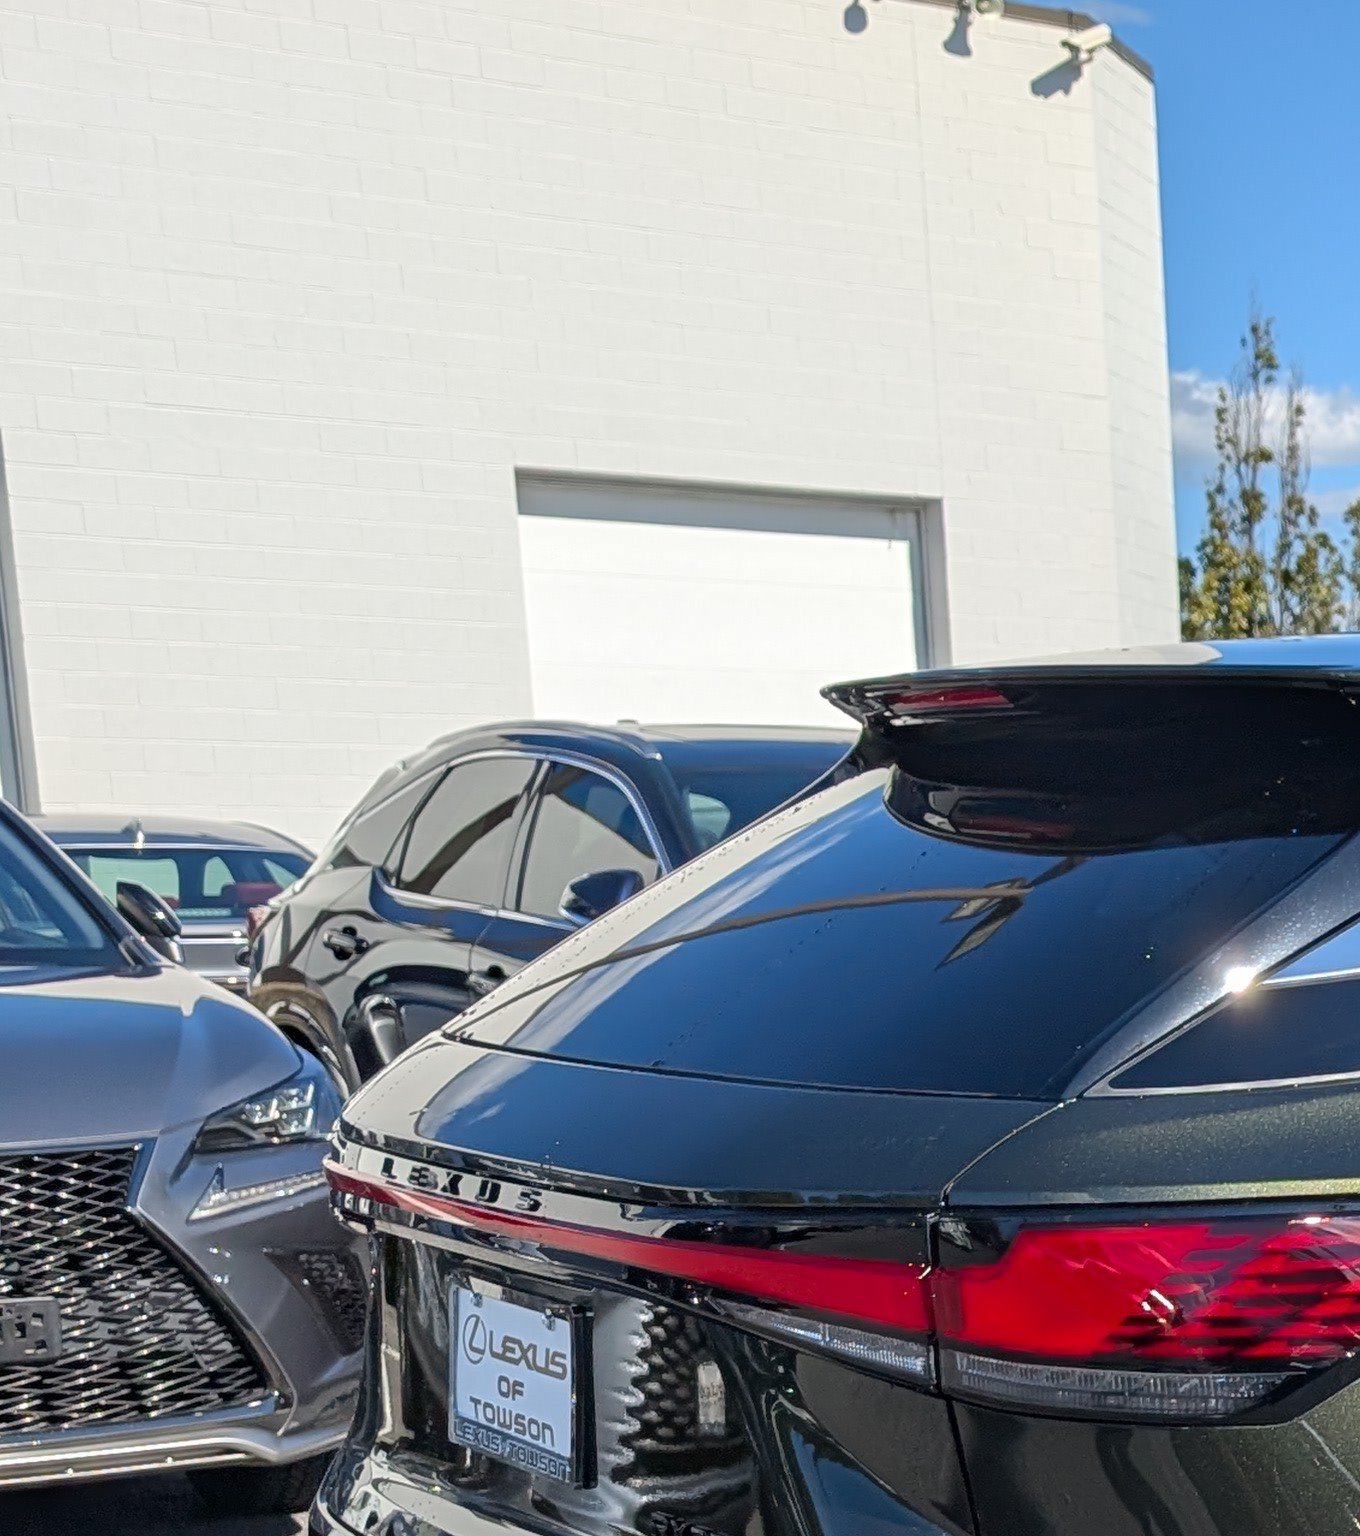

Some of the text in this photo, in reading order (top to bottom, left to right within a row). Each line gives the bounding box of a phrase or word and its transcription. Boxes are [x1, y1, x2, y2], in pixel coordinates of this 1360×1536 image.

[382, 1156, 545, 1213] LEXUS
[488, 1329, 568, 1381] LEXUS
[497, 1374, 525, 1401] OF
[453, 1419, 502, 1455] LEXUS
[469, 1395, 555, 1448] TOWSON
